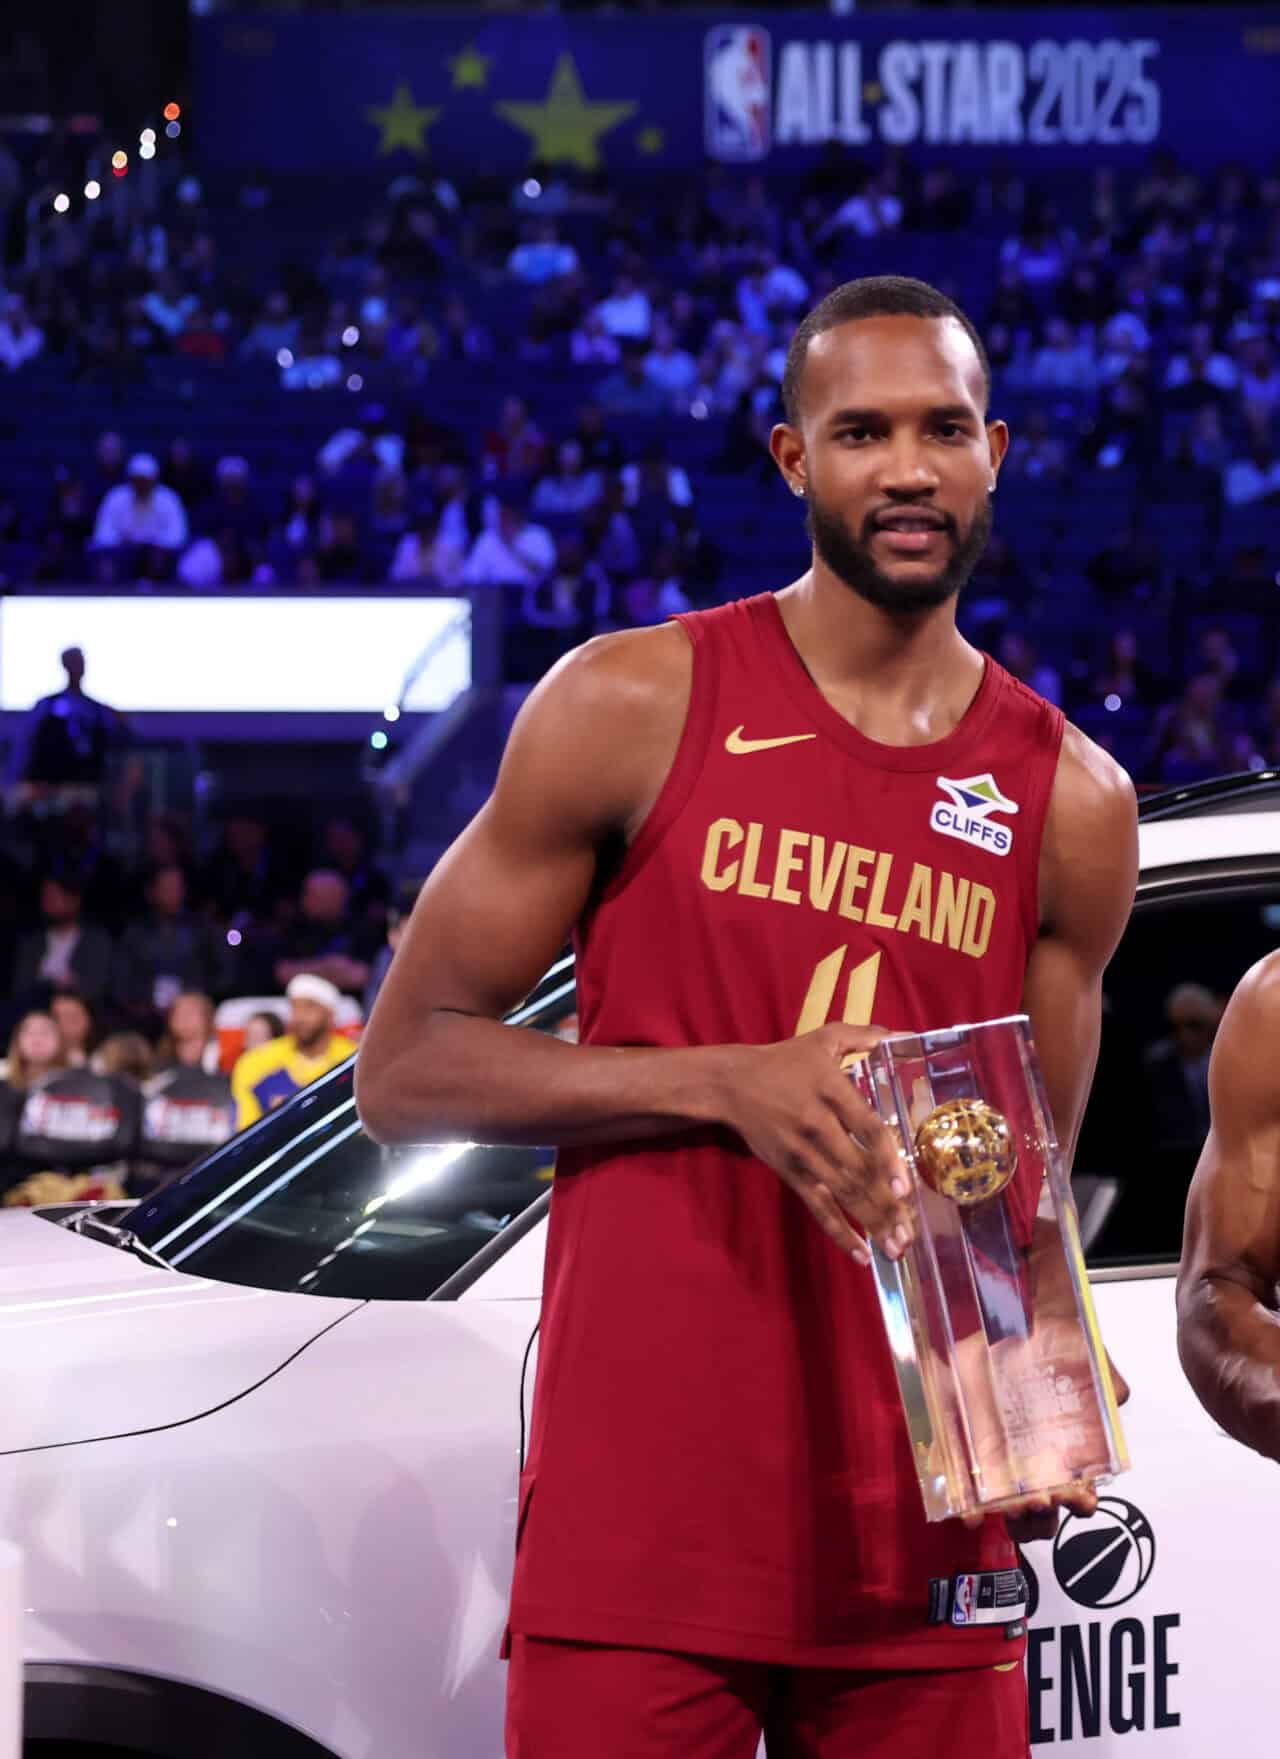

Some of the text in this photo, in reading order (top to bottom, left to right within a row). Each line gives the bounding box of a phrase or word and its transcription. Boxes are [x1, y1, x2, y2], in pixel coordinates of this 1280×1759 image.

[774, 38, 1160, 145] ALL STAR 2025
[934, 808, 1008, 850] CLIFFS
[701, 817, 996, 959] CLEVELAND
